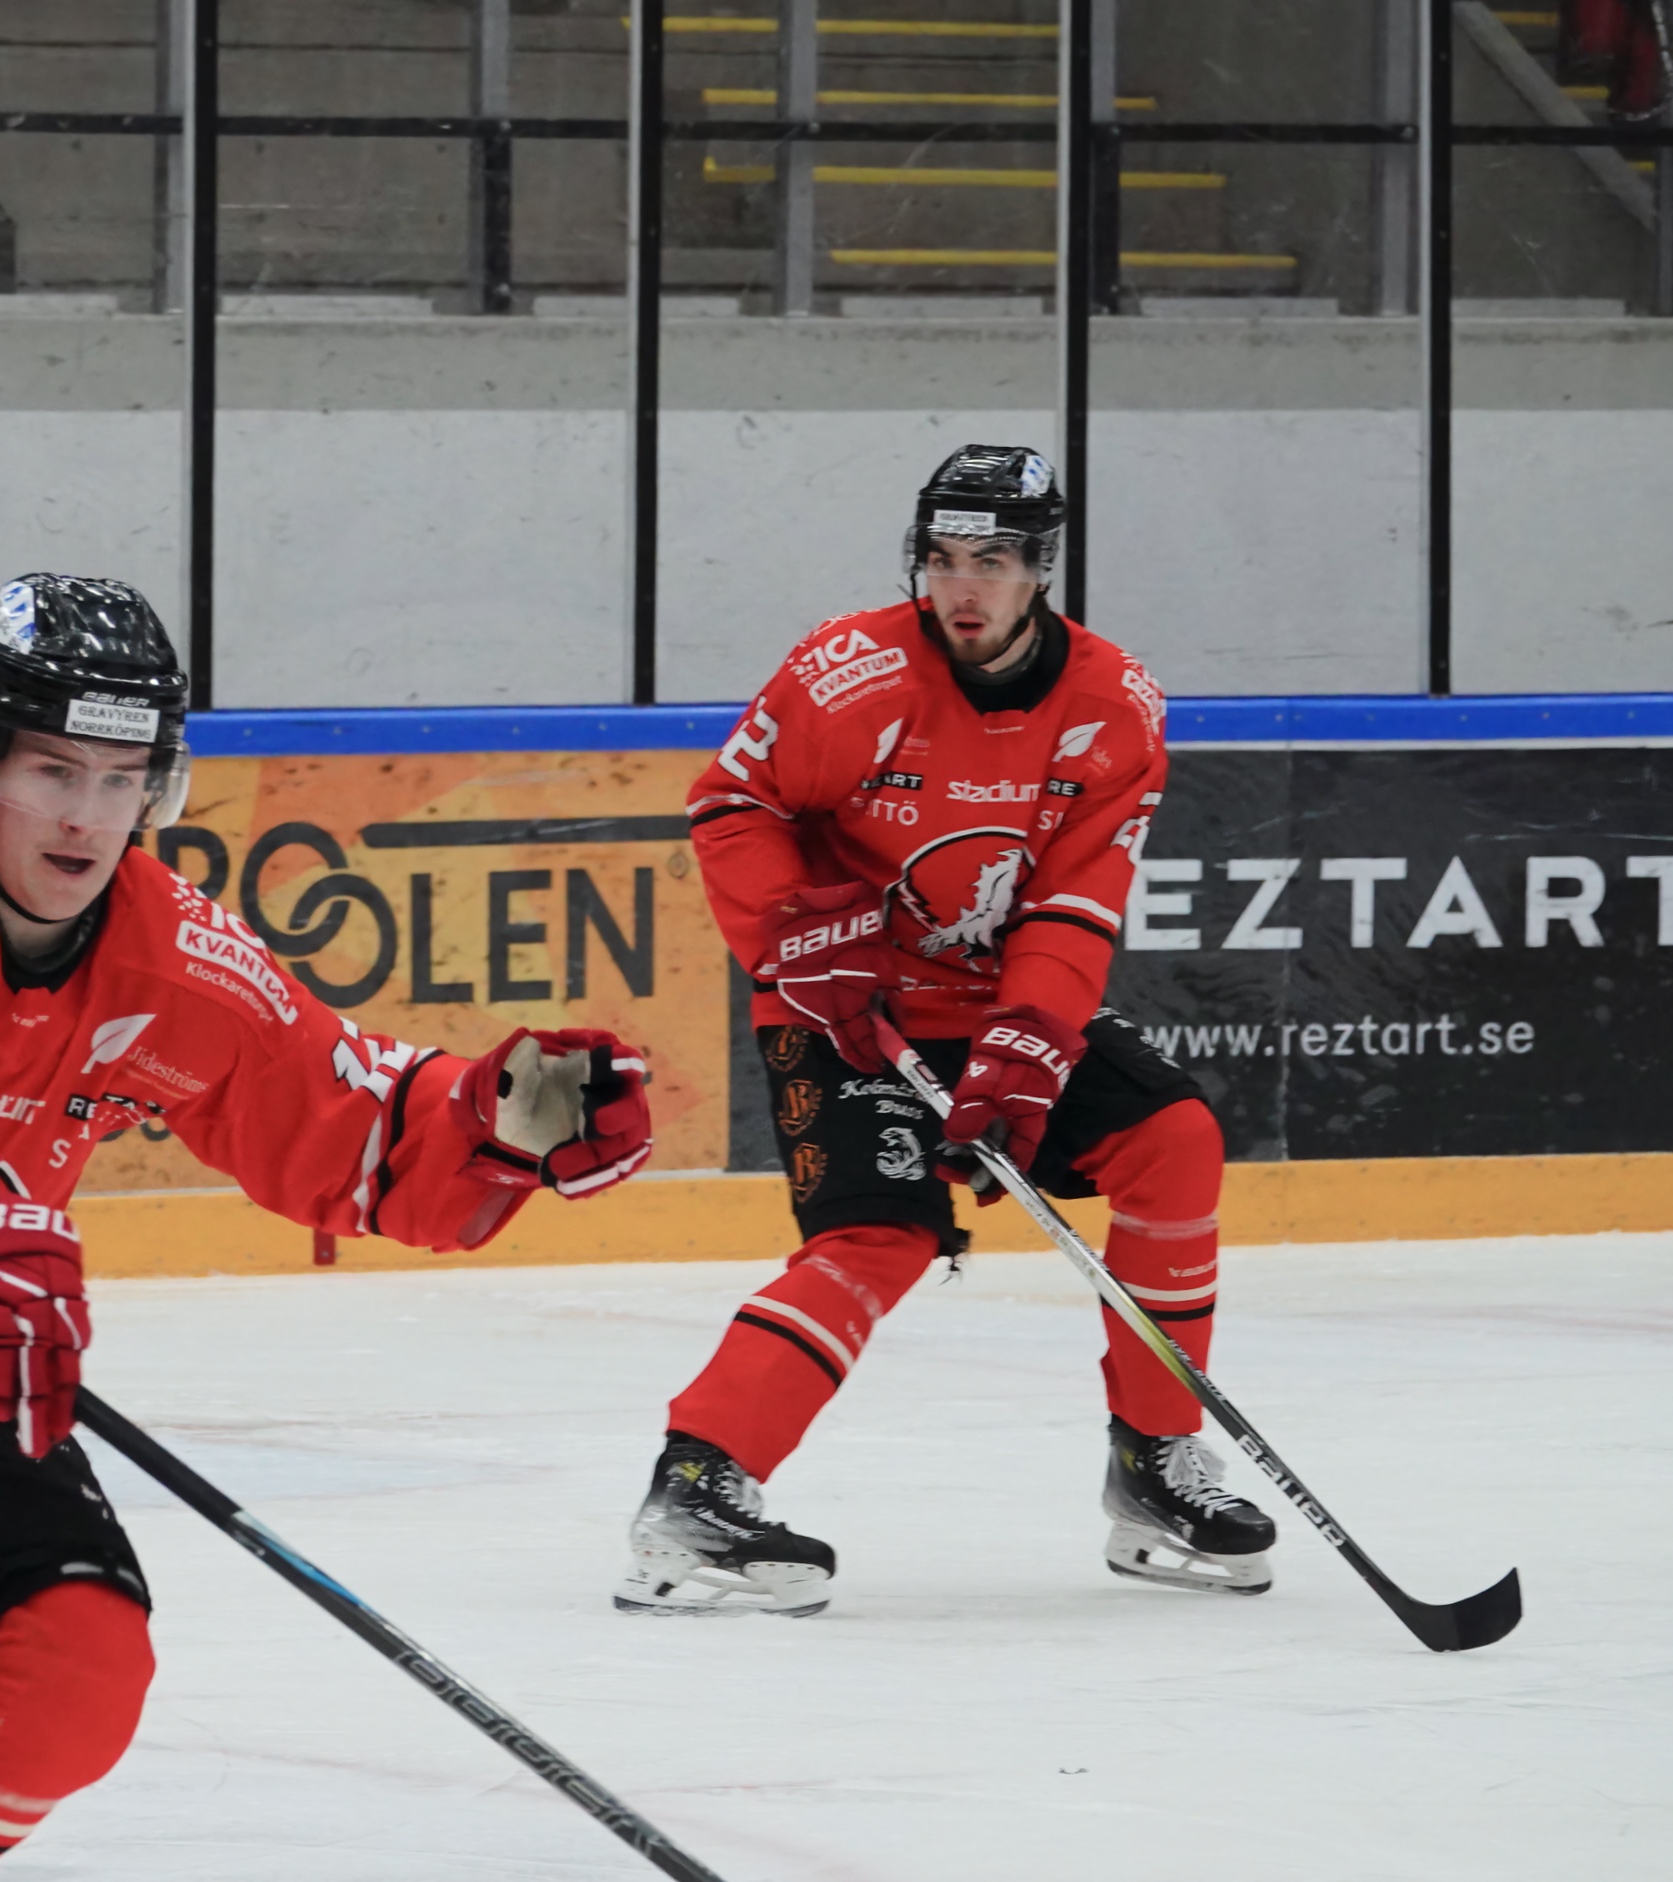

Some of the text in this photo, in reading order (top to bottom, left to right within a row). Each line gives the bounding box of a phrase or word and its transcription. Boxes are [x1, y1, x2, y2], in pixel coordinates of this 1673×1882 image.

[814, 628, 880, 673] ICA
[82, 691, 151, 708] BAUER
[815, 651, 902, 700] KVANTUM
[1123, 855, 1673, 951] EZTART
[779, 909, 883, 963] BAUE
